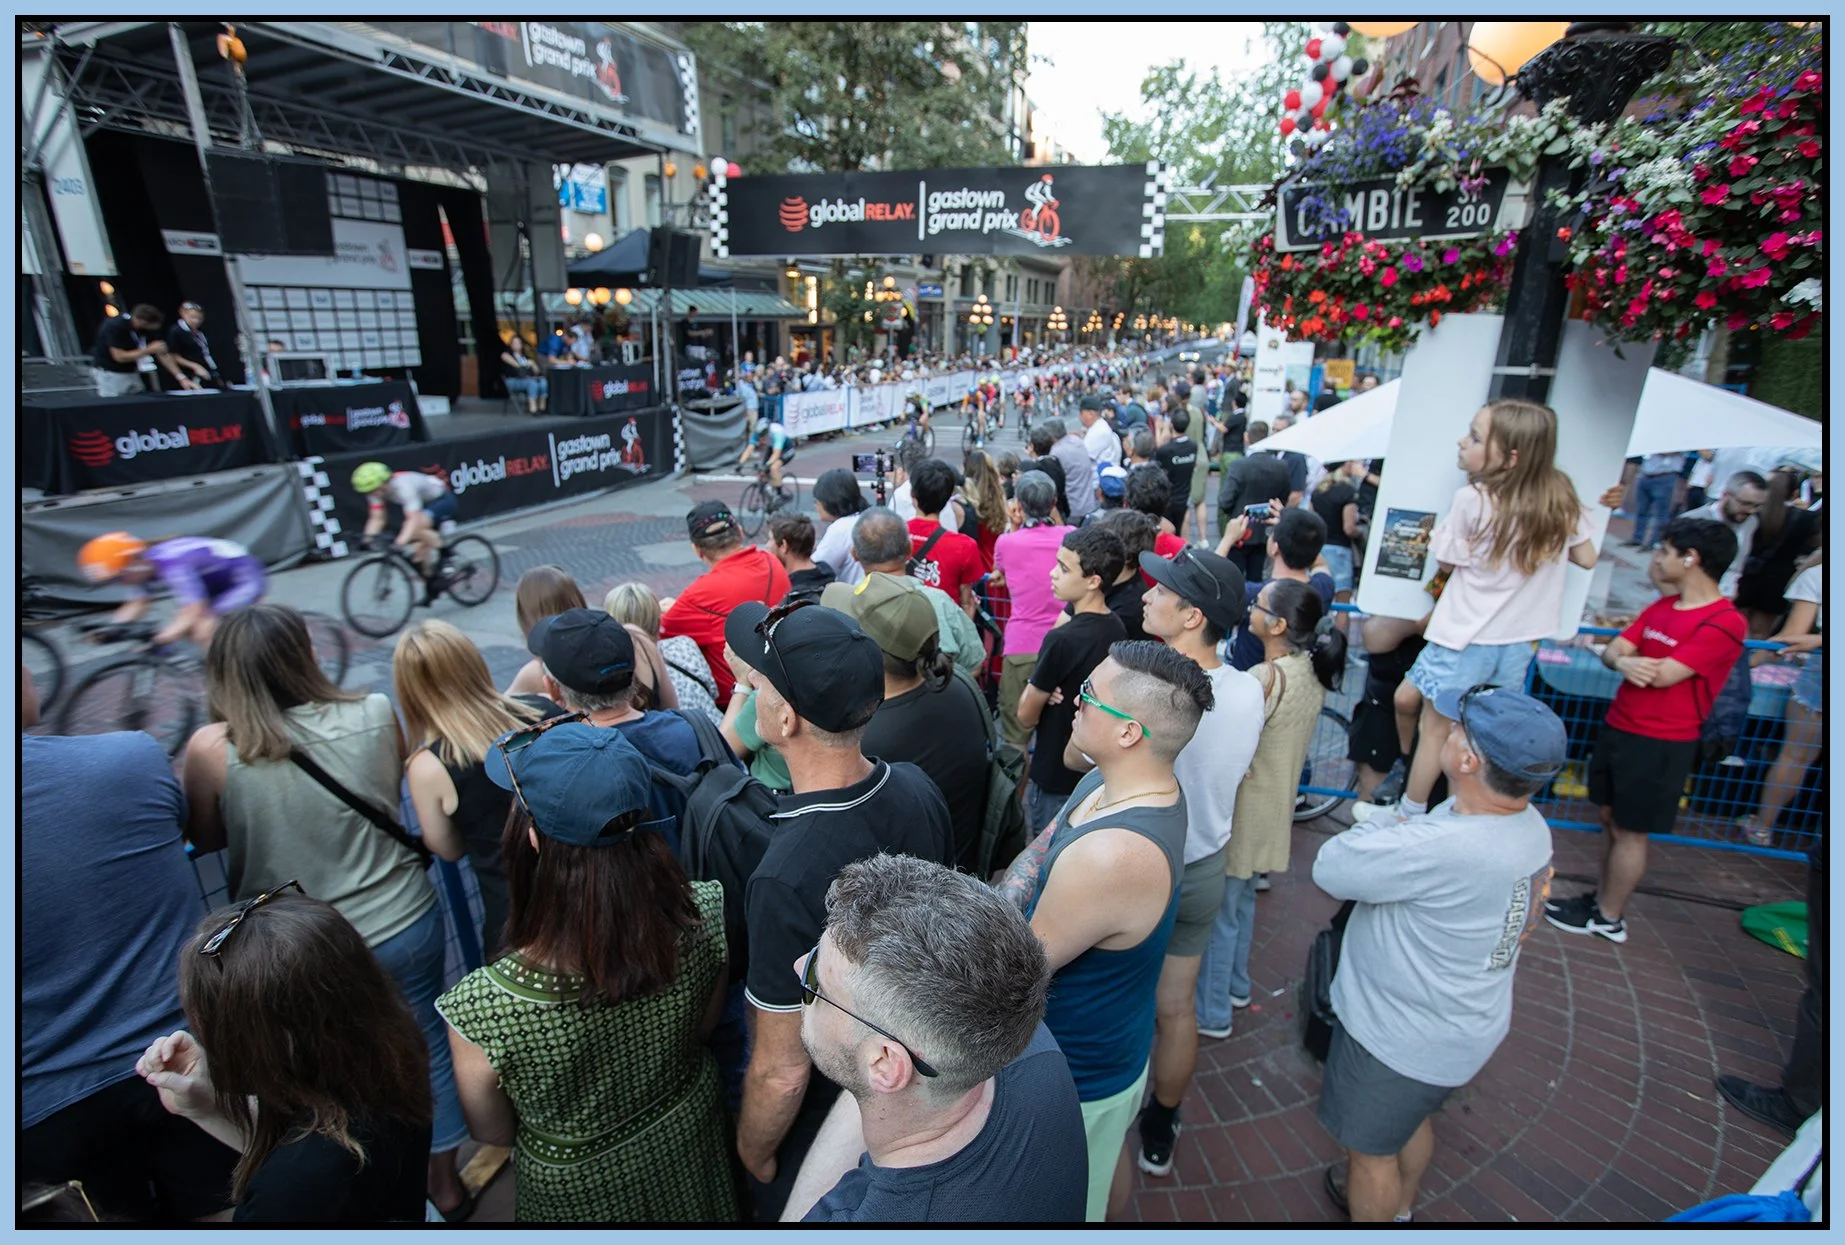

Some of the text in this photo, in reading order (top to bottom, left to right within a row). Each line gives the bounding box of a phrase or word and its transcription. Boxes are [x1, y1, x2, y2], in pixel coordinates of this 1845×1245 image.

[531, 43, 571, 70] grand
[927, 187, 1006, 215] gastown
[927, 208, 1019, 235] grand prix
[1445, 203, 1491, 228] 200
[557, 432, 611, 461] gastown
[559, 446, 622, 481] grand prix
